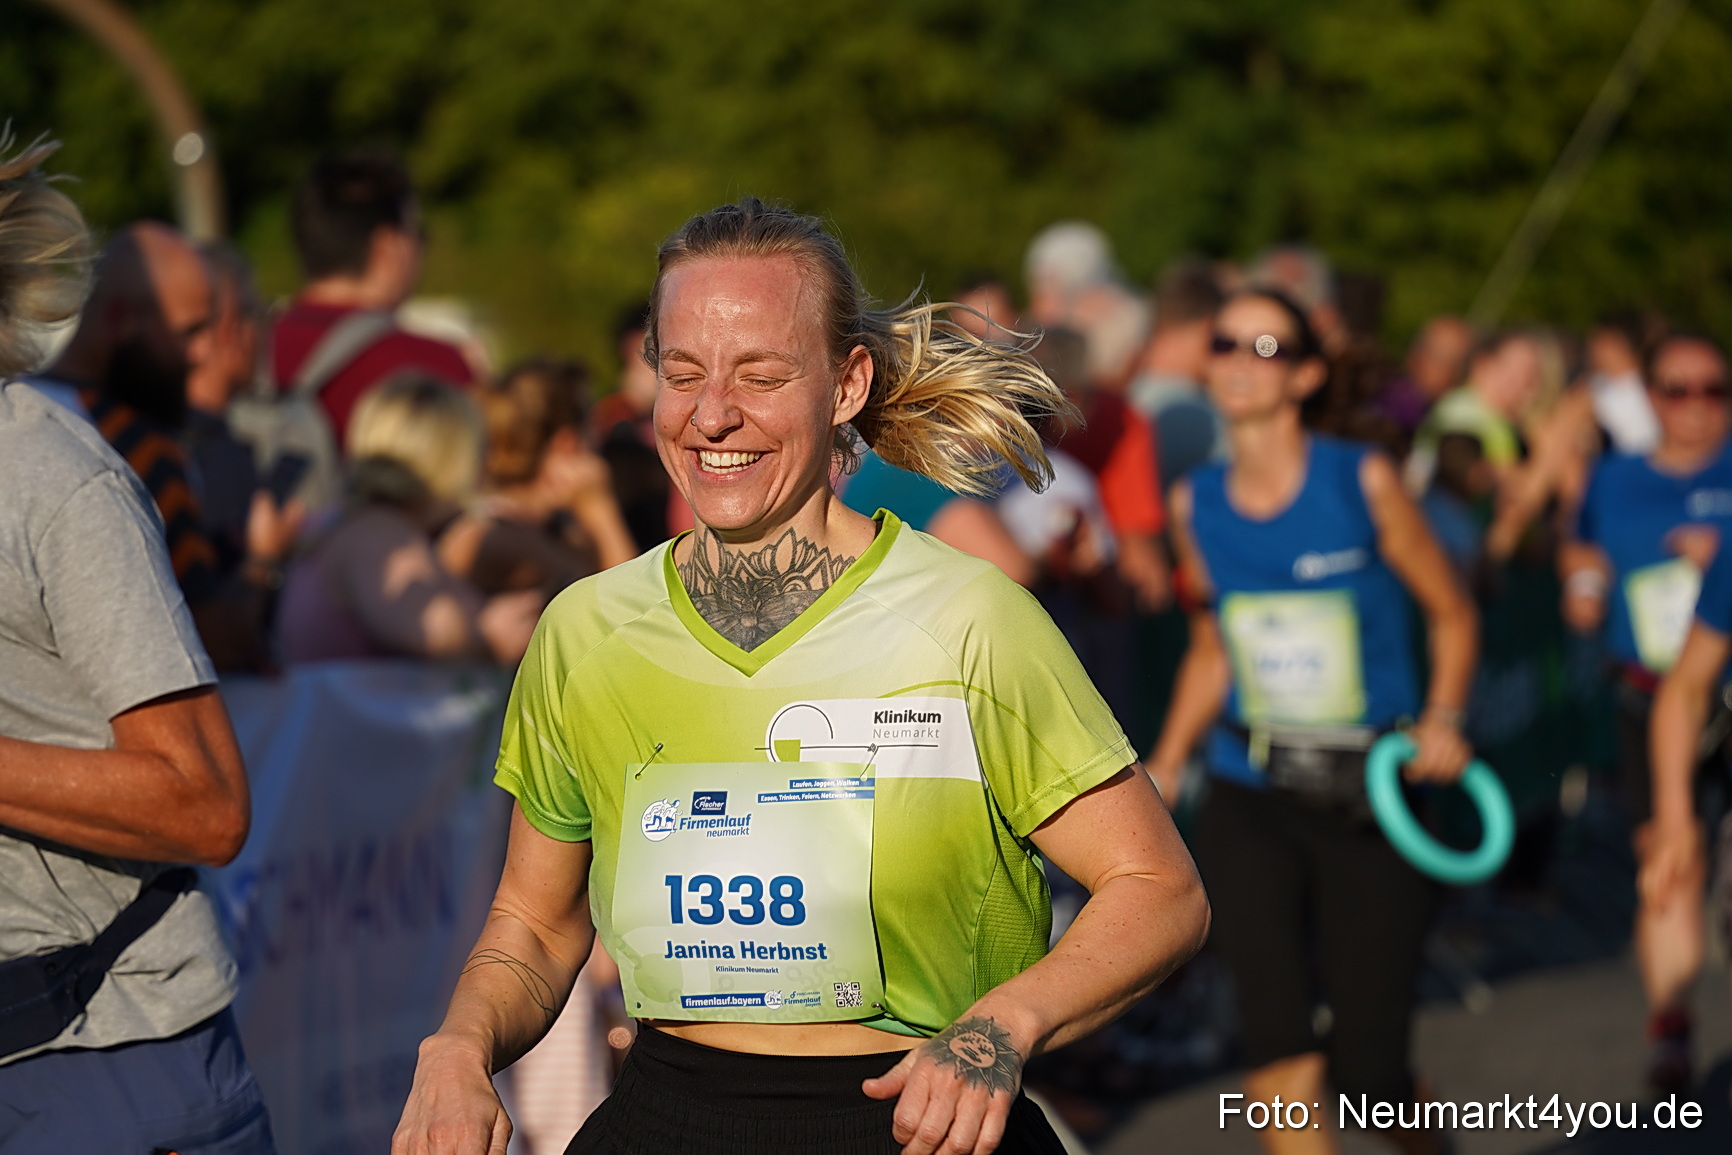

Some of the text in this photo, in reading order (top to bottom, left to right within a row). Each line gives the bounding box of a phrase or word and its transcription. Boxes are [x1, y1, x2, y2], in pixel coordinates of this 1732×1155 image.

[873, 709, 942, 725] Klinikum
[872, 727, 940, 739] Neumarkt
[836, 779, 860, 787] Walken
[699, 801, 725, 809] Fischer
[679, 814, 752, 831] Firmenlauf
[706, 827, 750, 838] neumarkt
[665, 874, 806, 926] 1338
[664, 940, 828, 961] Janina Herbnst
[746, 966, 779, 974] Neumarkt
[685, 996, 761, 1007] firmenlauf.bayern
[784, 996, 821, 1005] Firmenlauf
